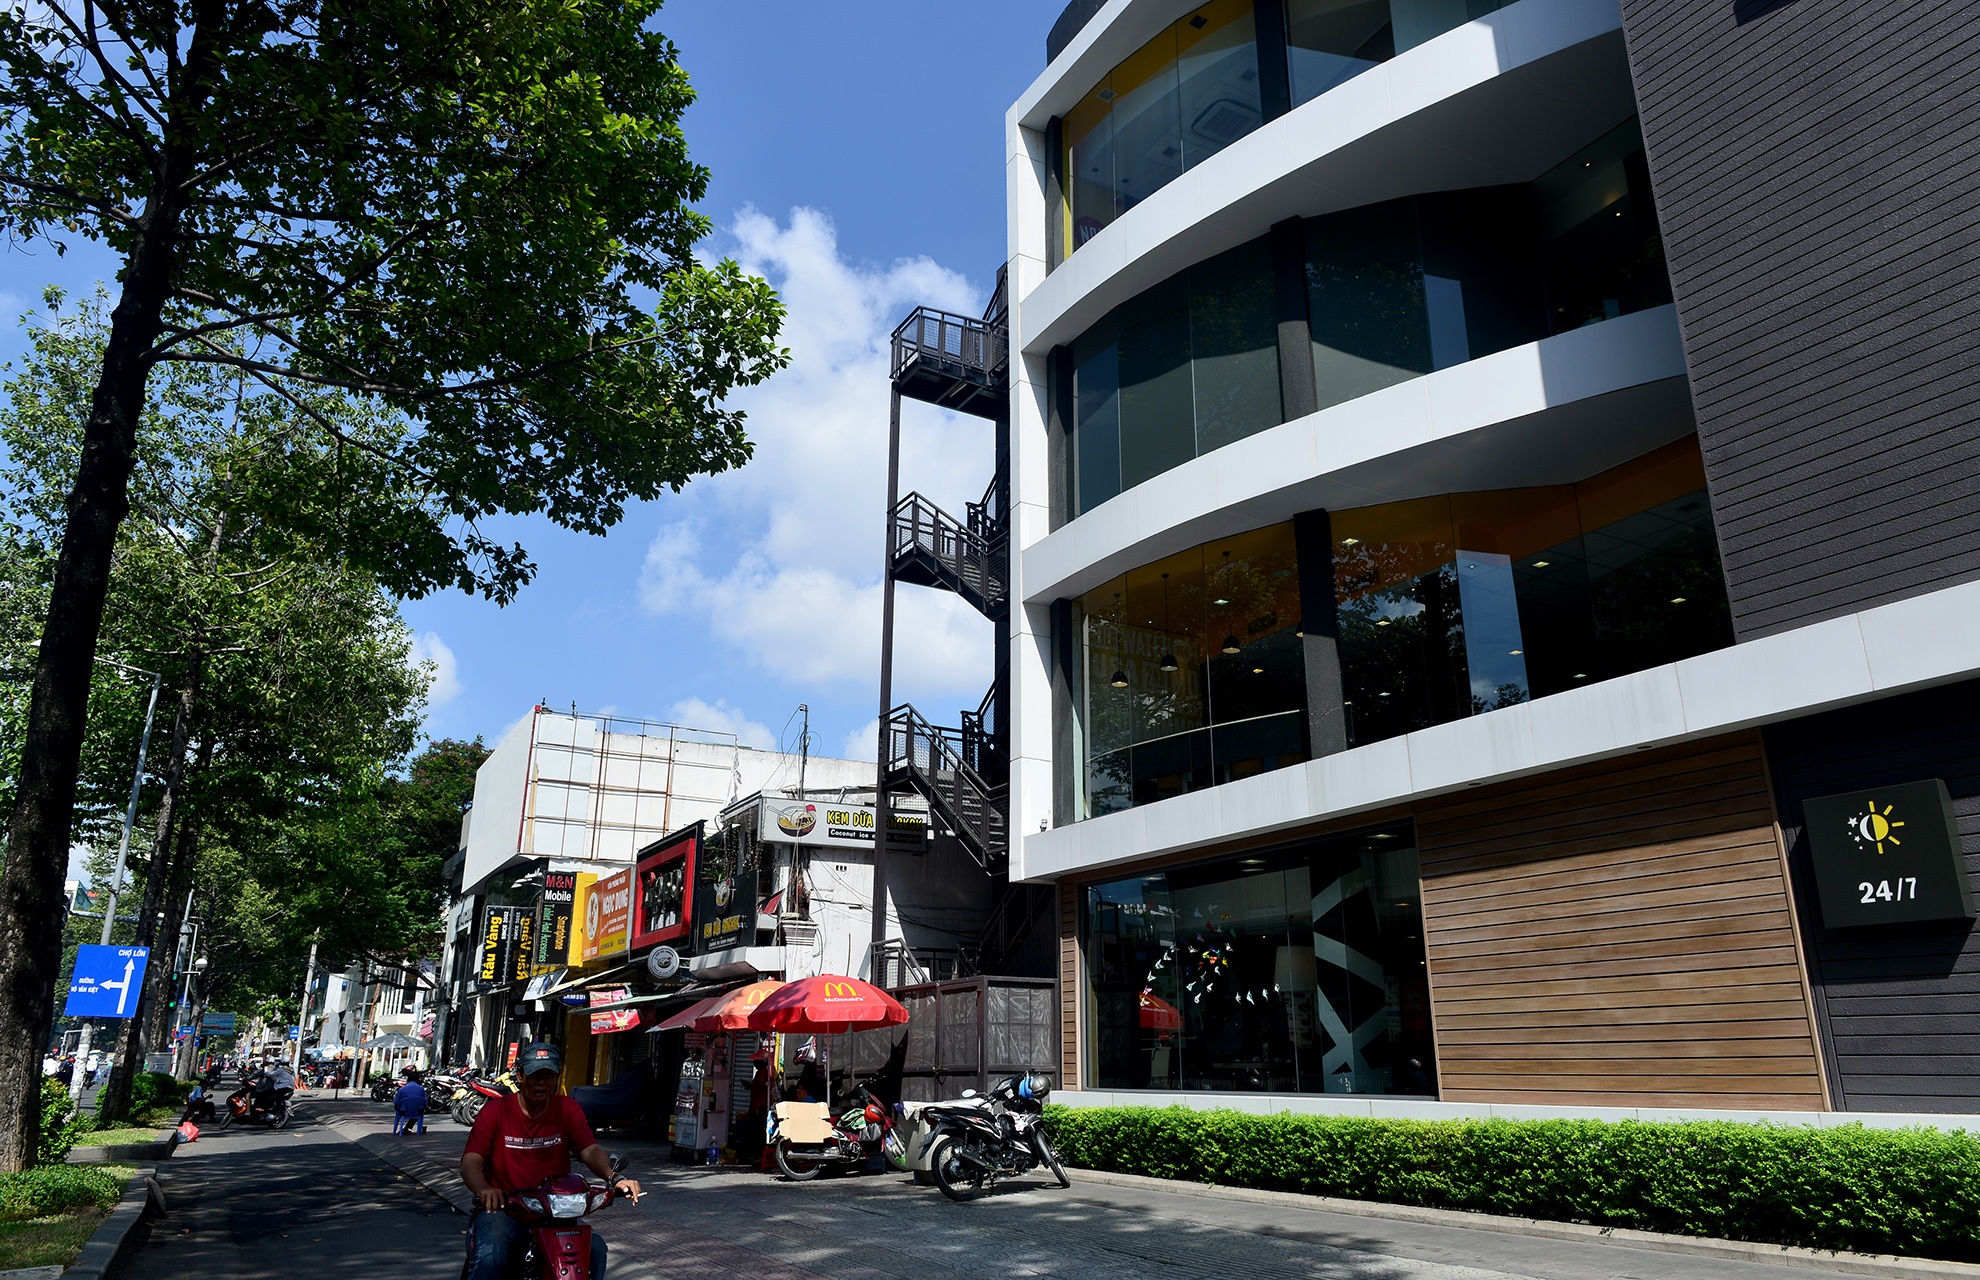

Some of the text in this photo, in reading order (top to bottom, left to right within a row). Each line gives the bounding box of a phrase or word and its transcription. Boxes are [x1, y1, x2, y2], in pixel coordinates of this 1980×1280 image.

[826, 809, 850, 826] KEM
[853, 809, 874, 828] DỪA
[830, 829, 857, 838] Coconut
[859, 831, 869, 839] ice
[545, 874, 574, 889] M&N
[544, 889, 572, 902] Mobile
[1858, 877, 1917, 904] 24/7
[542, 903, 555, 921] Tablet
[541, 921, 553, 933] And
[553, 915, 569, 950] Smartphone
[118, 949, 133, 958] CHỢ
[482, 916, 503, 980] Râu Vàng
